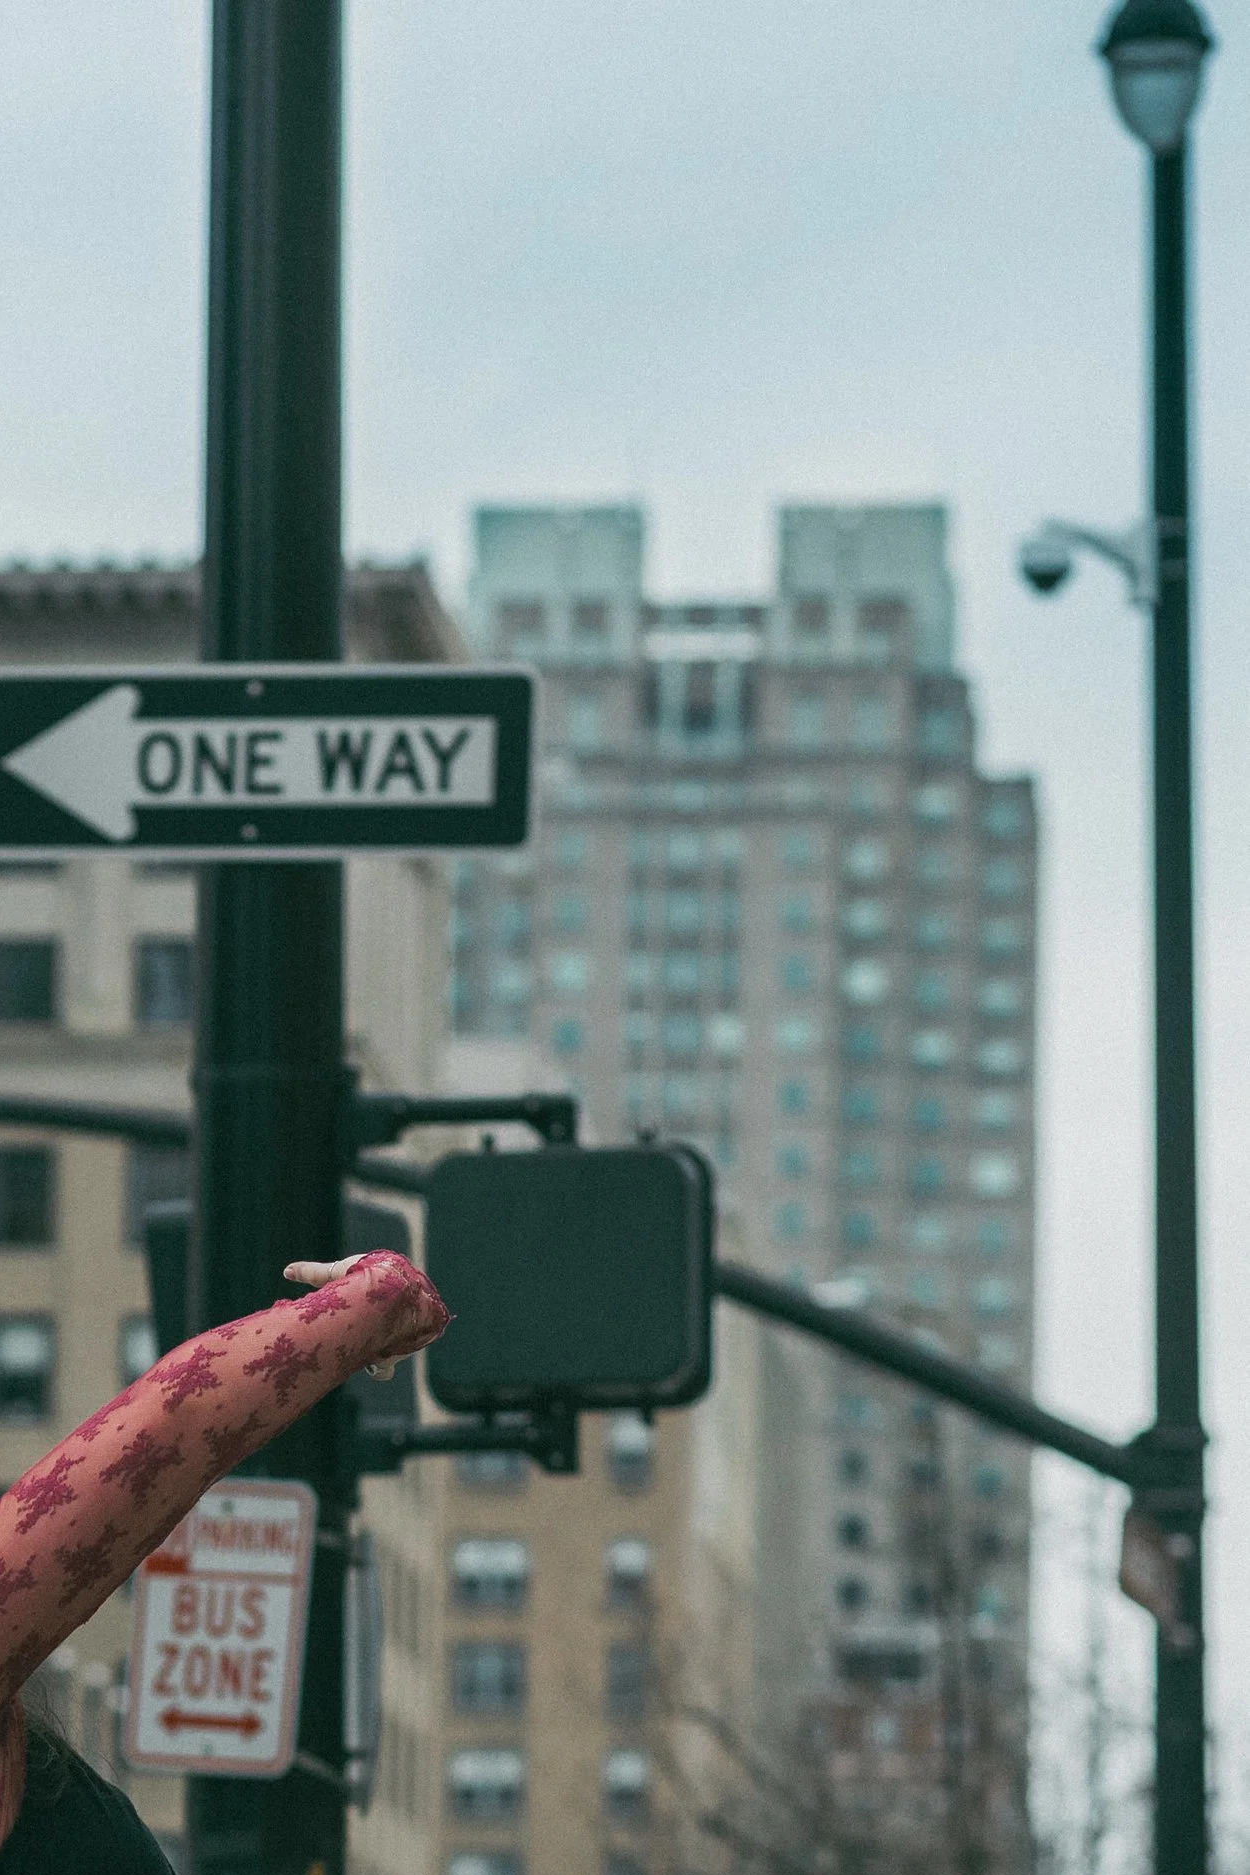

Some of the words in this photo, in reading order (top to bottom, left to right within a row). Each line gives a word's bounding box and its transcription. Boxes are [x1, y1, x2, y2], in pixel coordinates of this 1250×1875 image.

[136, 731, 283, 796] ONE
[317, 728, 470, 794] WAY
[171, 1584, 265, 1639] BUS
[153, 1643, 274, 1704] ZONE
